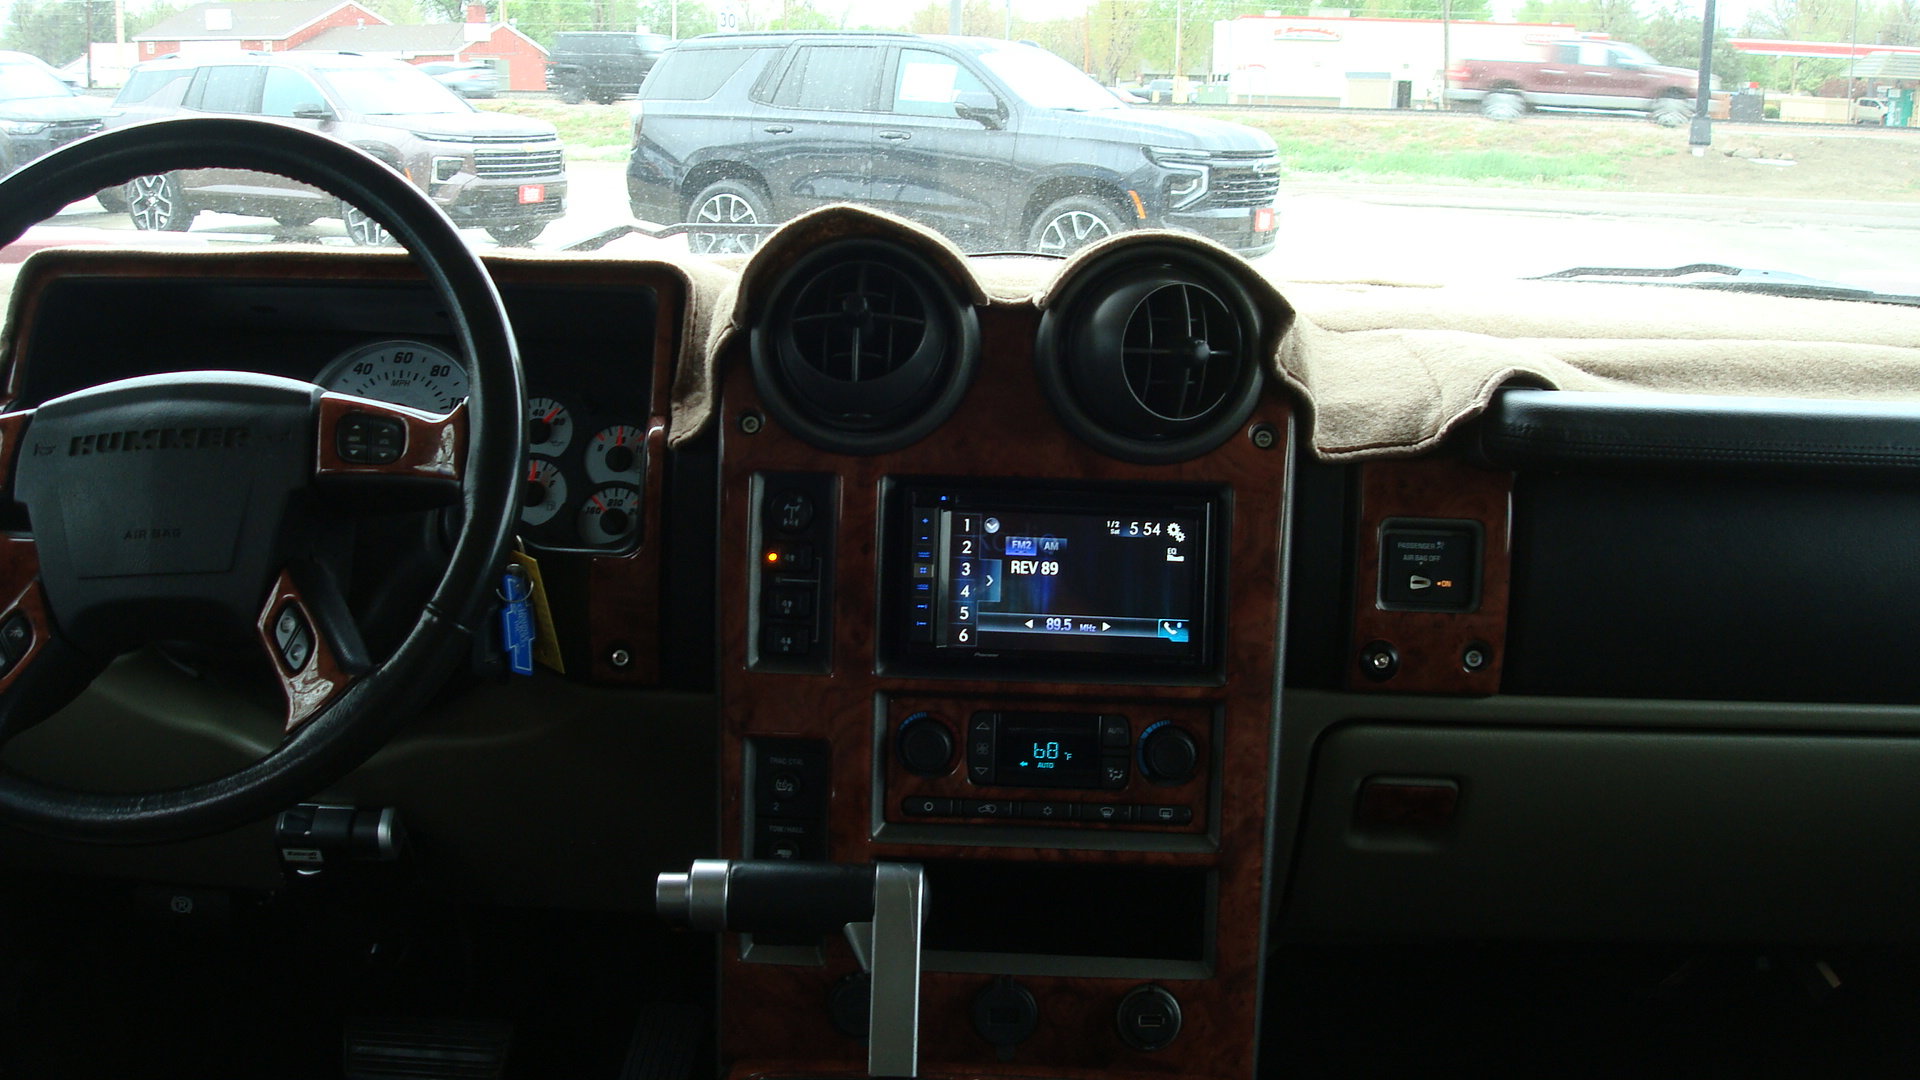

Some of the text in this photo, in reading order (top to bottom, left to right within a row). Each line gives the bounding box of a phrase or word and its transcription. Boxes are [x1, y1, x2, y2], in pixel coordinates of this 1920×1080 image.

[720, 12, 736, 28] 30
[393, 352, 413, 364] 60
[353, 363, 373, 375] 40
[430, 365, 450, 377] 80
[68, 427, 249, 456] HUMMER
[964, 518, 970, 532] 1
[962, 540, 972, 554] 2
[1011, 540, 1032, 550] FM2
[1043, 541, 1060, 551] AM
[1167, 547, 1177, 555] EQ
[961, 562, 971, 576] 3
[1010, 560, 1059, 575] REV 89
[960, 584, 970, 598] 4
[959, 606, 969, 620] 5
[1046, 617, 1097, 632] 89.5 MHz
[958, 628, 969, 642] 6
[1033, 741, 1059, 760] 68
[1037, 761, 1055, 769] AUTO
